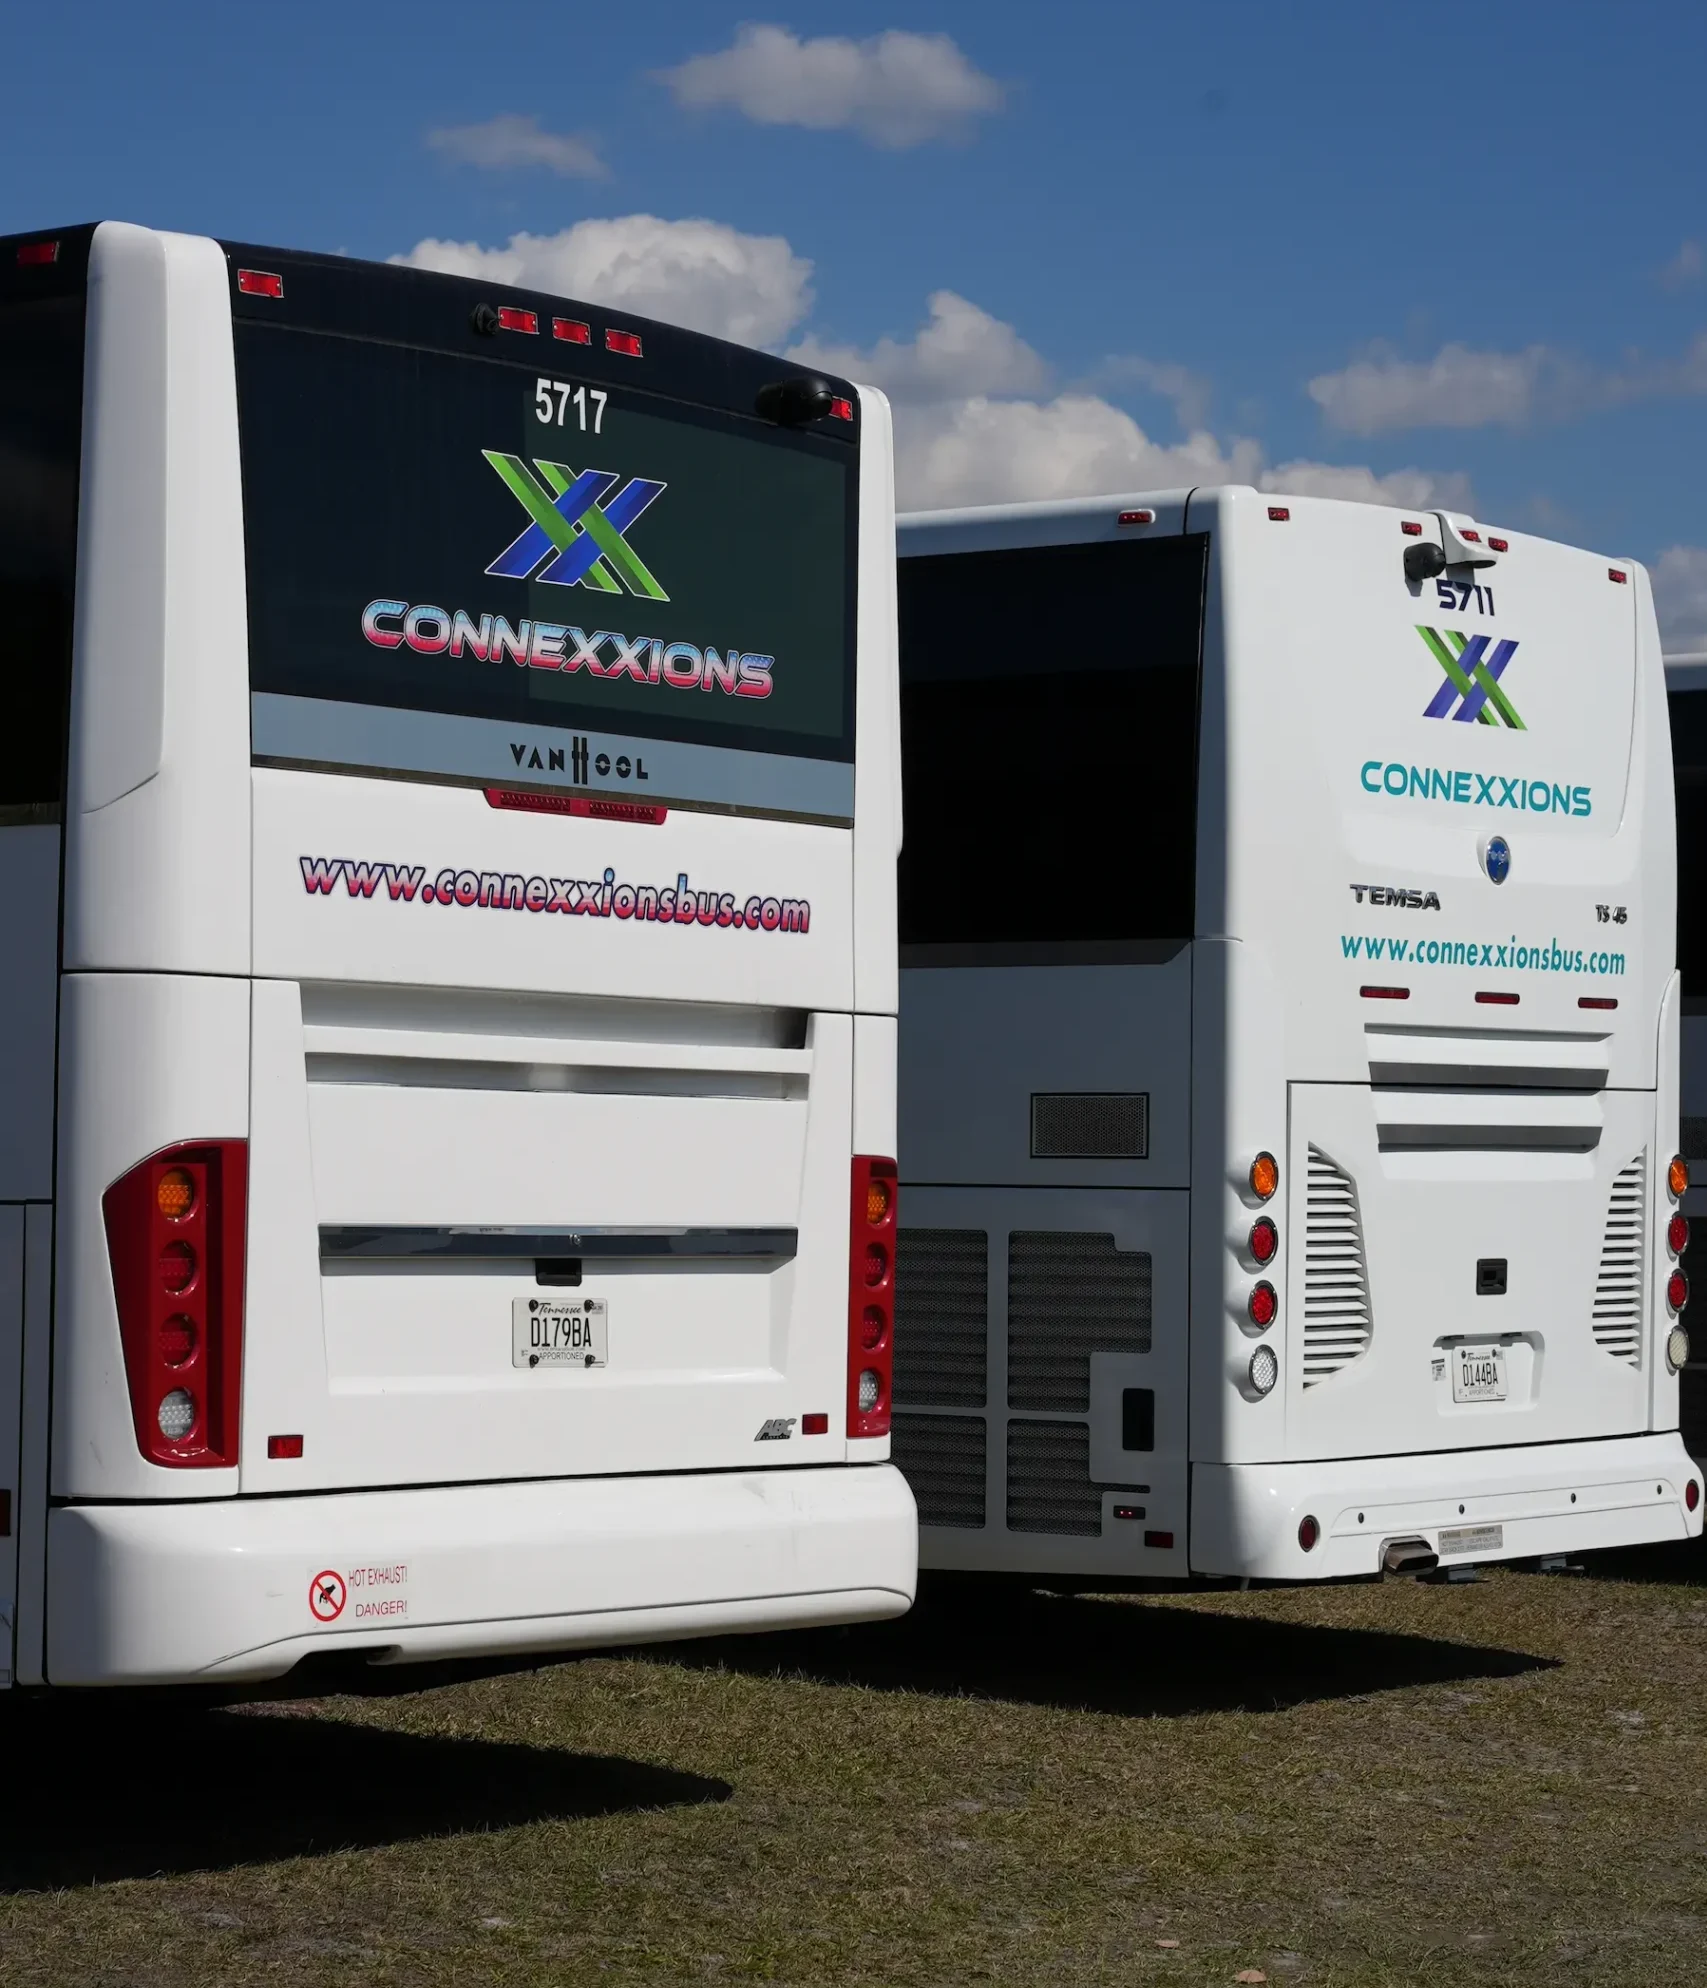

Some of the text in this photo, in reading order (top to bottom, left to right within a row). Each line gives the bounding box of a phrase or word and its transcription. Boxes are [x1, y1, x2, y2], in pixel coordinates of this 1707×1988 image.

[535, 377, 608, 435] 5717
[1435, 578, 1495, 617] 5711
[361, 598, 775, 700] CONNEXXIONS
[1360, 760, 1592, 817] CONNEXXIONS
[299, 855, 811, 934] www.connexxionsbus.com
[1349, 883, 1441, 912] TEMSA
[1595, 904, 1610, 924] TS
[1341, 934, 1626, 976] www.connexxionsbus.com
[539, 1302, 581, 1315] Tennessee
[531, 1317, 592, 1347] D179BA
[539, 1351, 585, 1360] APPORTIONED
[1462, 1362, 1499, 1386] D144BA
[753, 1417, 798, 1442] ABC
[348, 1565, 408, 1587] HOT EXHAUST!
[355, 1600, 407, 1617] DANGER!
